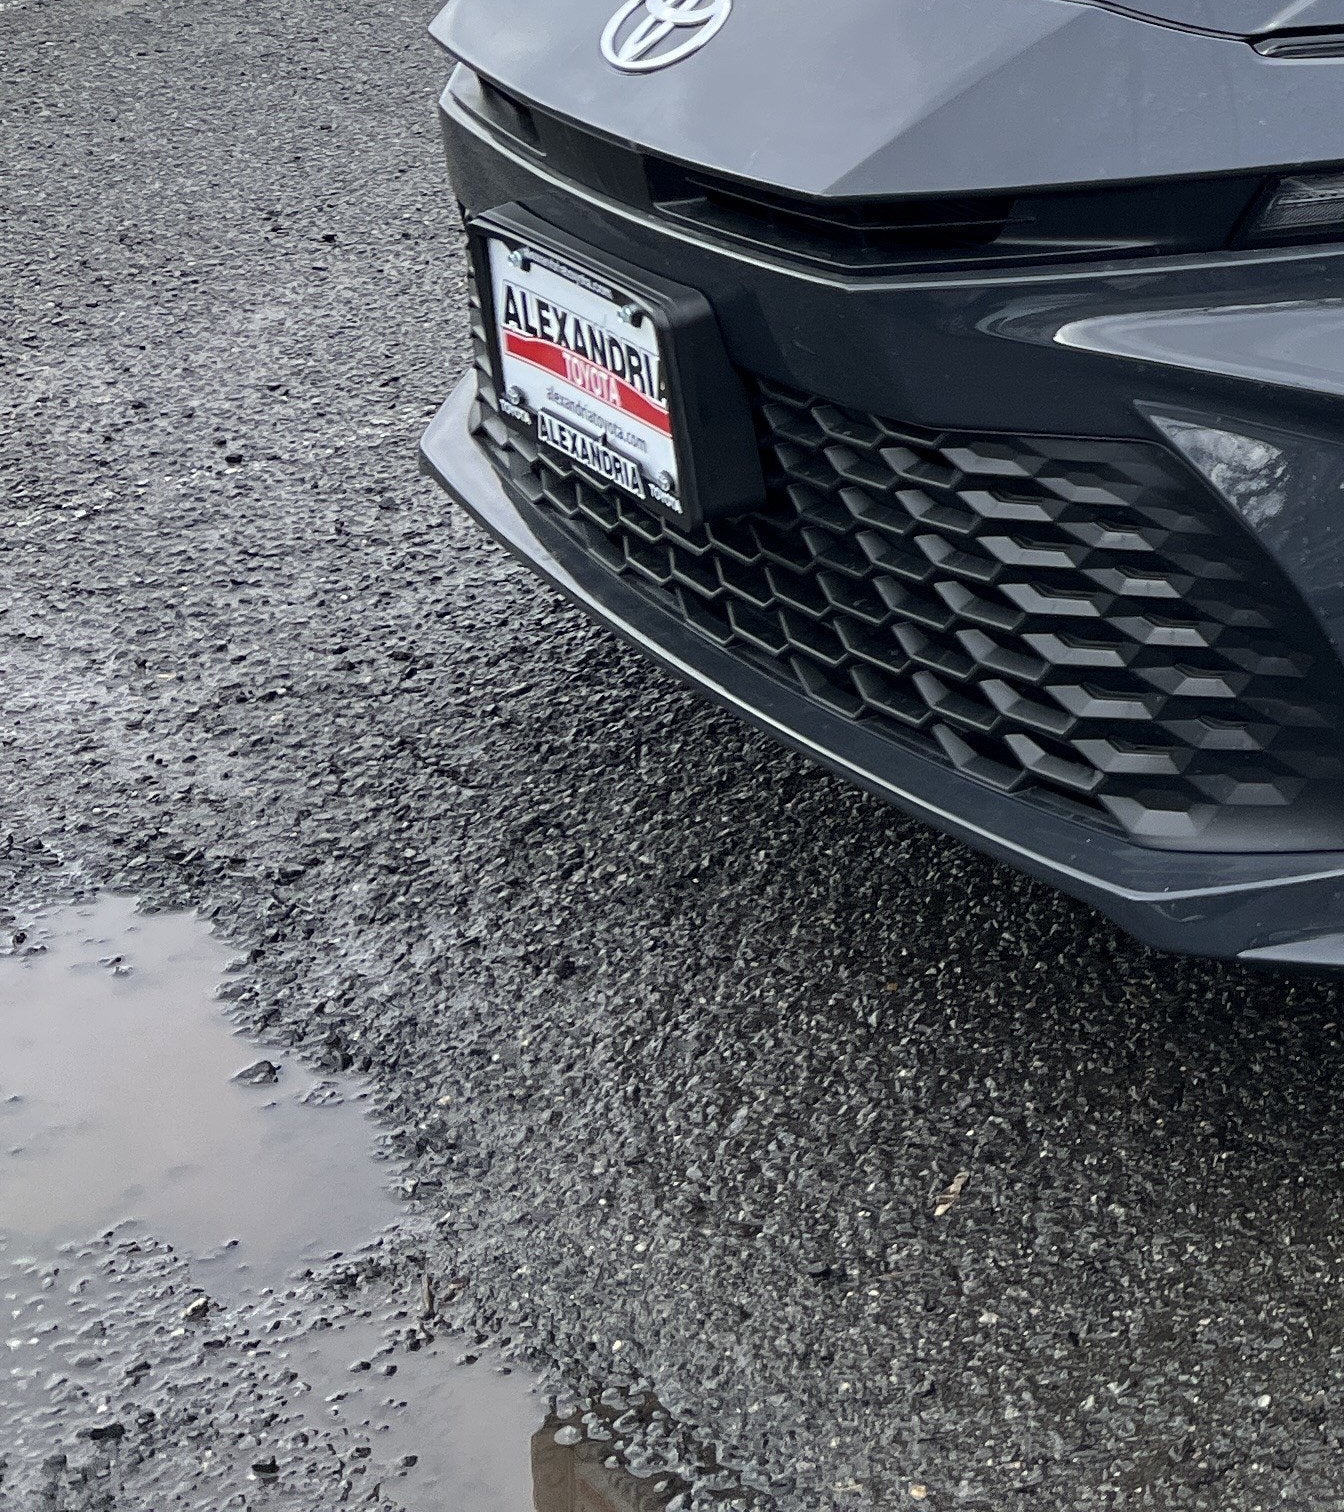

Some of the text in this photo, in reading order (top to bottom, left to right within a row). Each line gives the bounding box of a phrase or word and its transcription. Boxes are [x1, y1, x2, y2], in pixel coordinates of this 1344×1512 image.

[504, 284, 661, 401] ALEXANDRI
[562, 350, 622, 408] TOYOTA
[539, 411, 646, 499] ALEXANDRIA
